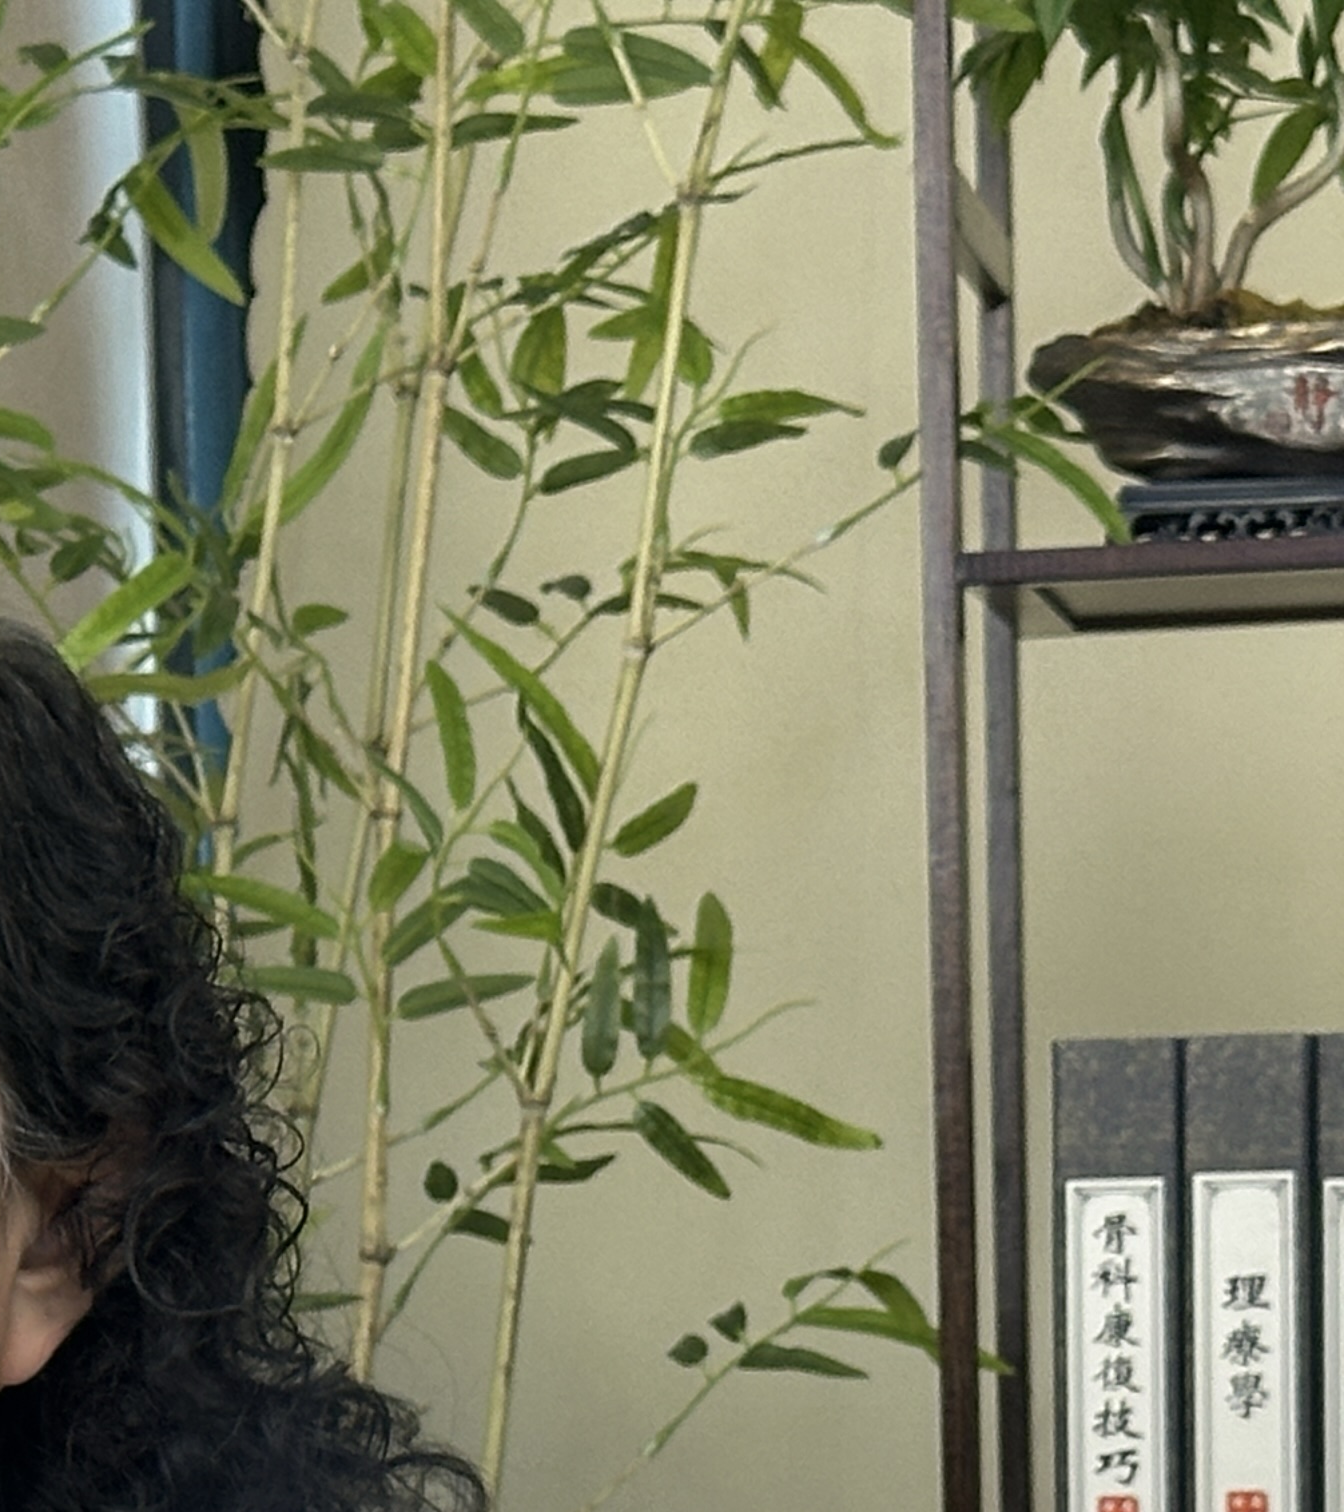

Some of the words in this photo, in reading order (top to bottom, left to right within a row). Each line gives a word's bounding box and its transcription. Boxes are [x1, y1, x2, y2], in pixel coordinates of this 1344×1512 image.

[1090, 1212, 1145, 1487] 骨科康復技巧
[1219, 1272, 1272, 1419] 理療學
